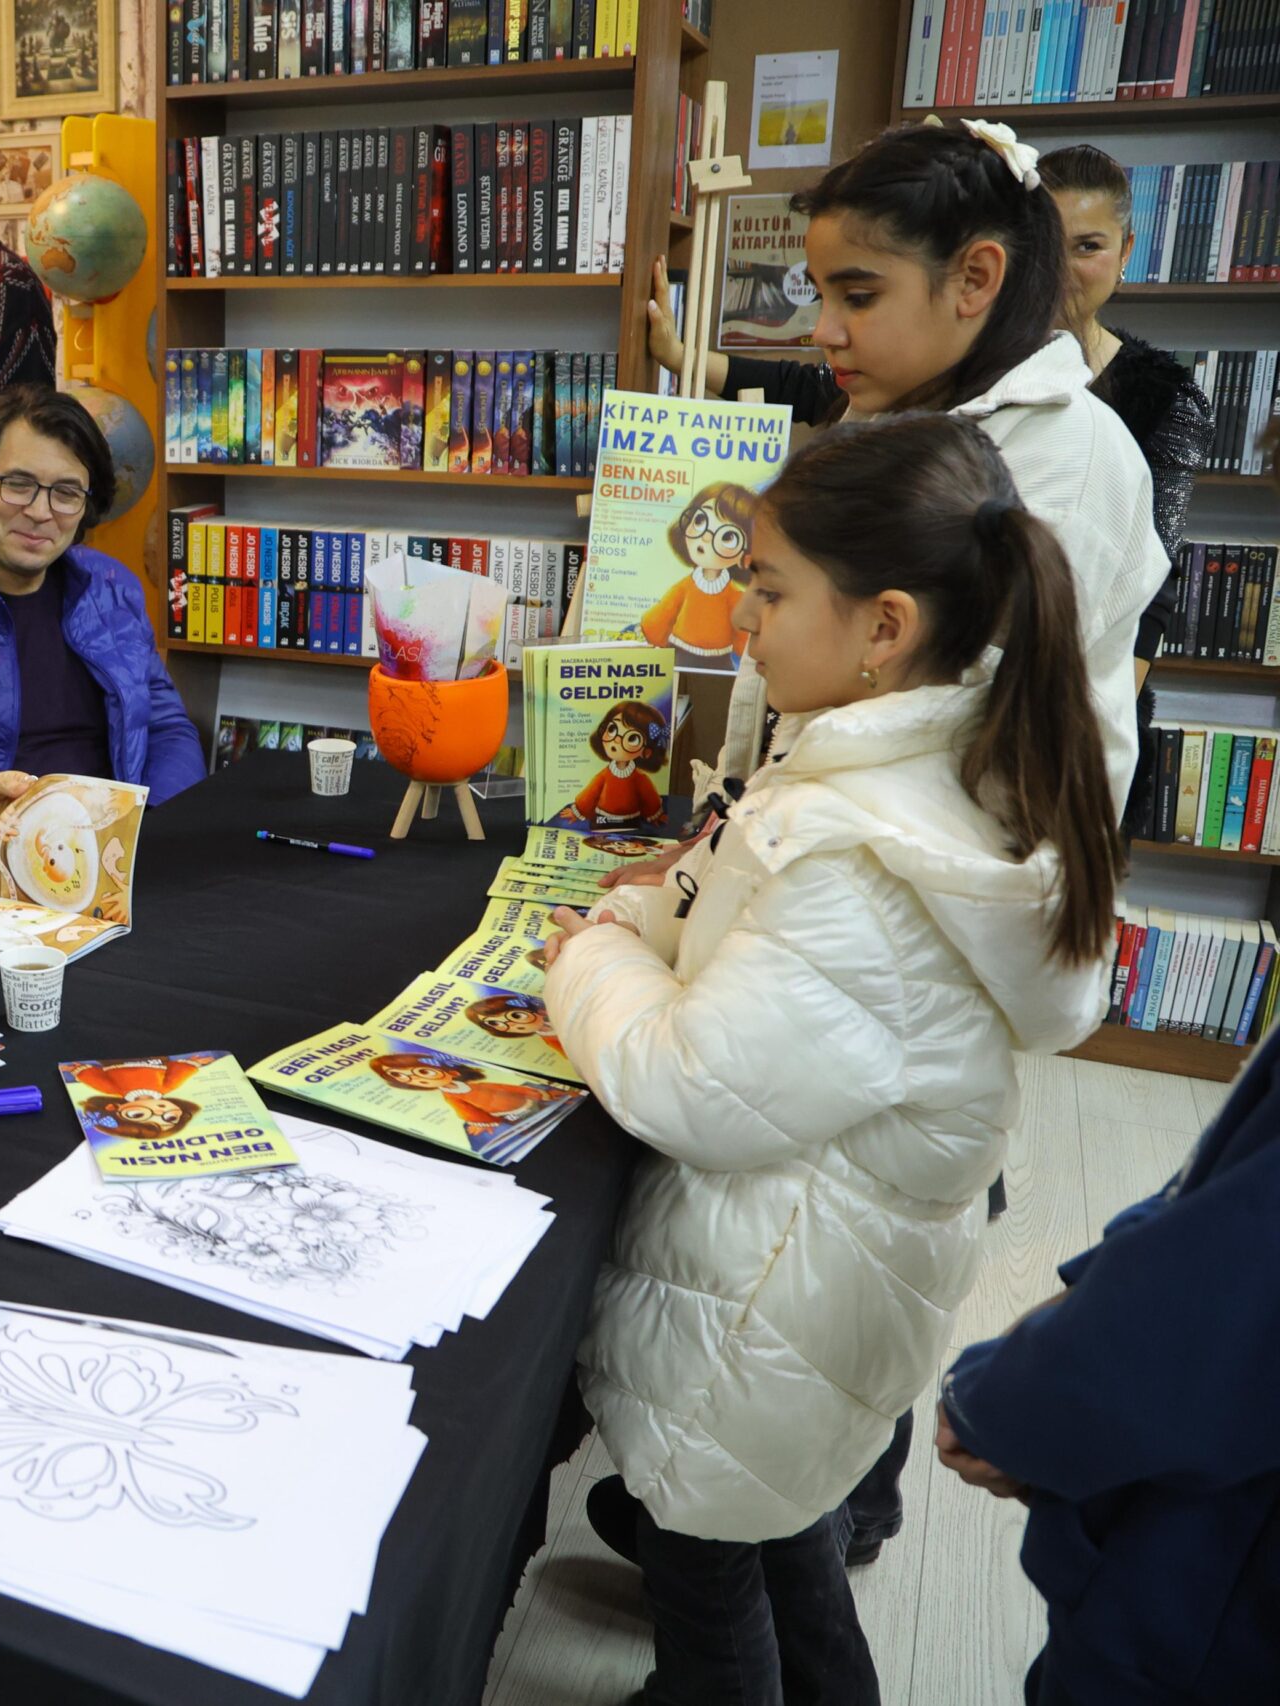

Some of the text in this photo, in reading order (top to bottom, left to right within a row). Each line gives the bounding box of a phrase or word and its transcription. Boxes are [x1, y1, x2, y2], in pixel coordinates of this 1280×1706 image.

[253, 16, 273, 53] Kule
[558, 127, 570, 182] GRANGÉ
[457, 193, 467, 253] LONTANO
[533, 191, 544, 251] LONTANO
[733, 216, 792, 232] KÜLTÜR
[603, 401, 783, 434] KİTAP TANITIMI
[601, 422, 781, 463] İMZA GÜNÜ
[602, 464, 690, 485] BEN NASIL
[600, 483, 675, 503] GELDİM?
[229, 532, 239, 576] JO NESBO
[246, 533, 256, 578] JO NESBO
[283, 535, 291, 547] JO
[298, 535, 307, 580] JO NESBO
[371, 538, 380, 551] JO
[413, 541, 422, 555] JO
[433, 543, 442, 556] JO
[452, 543, 461, 556] JO
[473, 544, 482, 557] JO
[495, 546, 504, 558] JO
[514, 547, 523, 559] JO
[532, 550, 541, 563] JO
[569, 551, 579, 564] JO
[590, 545, 627, 557] GROSS
[282, 548, 291, 580] NESBO
[315, 536, 325, 582] JO NESBO
[332, 537, 342, 583] JO NESBO
[351, 538, 361, 584] JO NESBO
[546, 549, 556, 597] JO NESBO
[513, 560, 522, 593] NESBO
[529, 564, 539, 597] NESBO
[560, 664, 666, 679] BEN NASIL
[560, 682, 644, 700] GELDİM?
[523, 910, 546, 939] ELDİM?
[456, 957, 486, 979] BEN
[476, 935, 511, 957] NASIL
[482, 945, 527, 983] GELDİM?
[387, 1010, 422, 1033] BEN
[413, 980, 456, 1012] NASIL
[1148, 964, 1165, 1017] JOHN BOYNE
[414, 996, 469, 1039] GELDİM?
[277, 1033, 372, 1077] BEN NASIL
[304, 1047, 379, 1084] GELDİM?
[109, 1141, 275, 1166] BEN NASIL
[139, 1128, 265, 1151] GELDİM?
